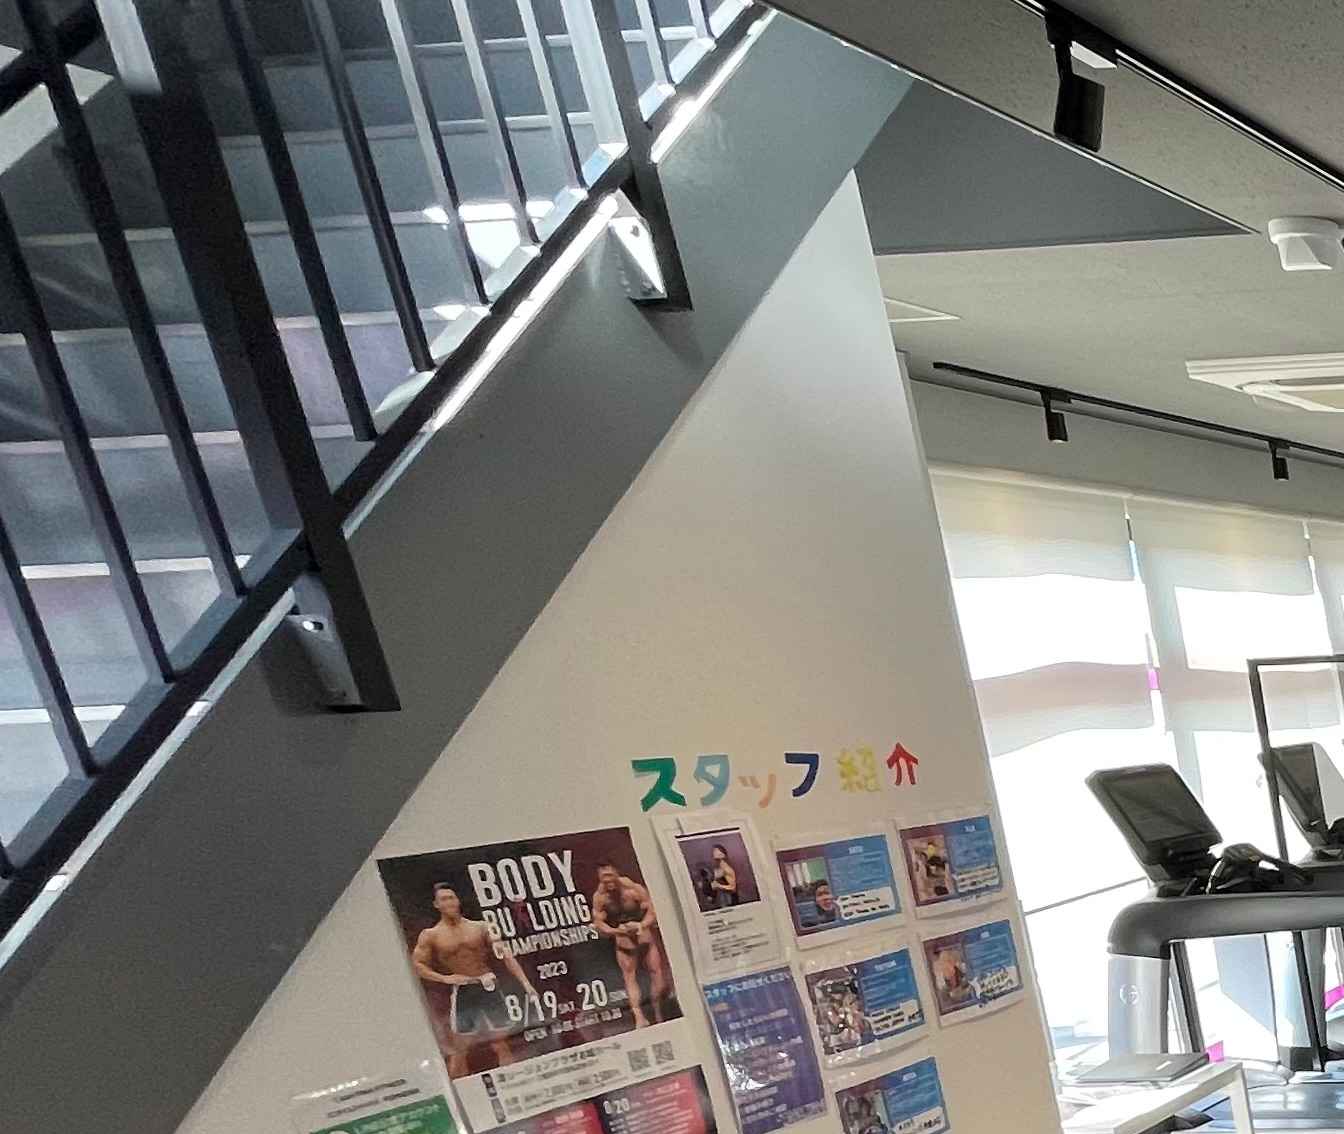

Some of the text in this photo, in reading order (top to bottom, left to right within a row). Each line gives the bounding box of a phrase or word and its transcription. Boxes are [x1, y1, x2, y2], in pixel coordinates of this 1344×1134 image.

[631, 742, 919, 812] スタッフ紹介
[468, 851, 576, 907] BODY
[493, 924, 599, 960] CHAMPIONSHIPS
[537, 961, 568, 980] 2023
[504, 991, 558, 1025] 8/19
[576, 979, 608, 1011] 20
